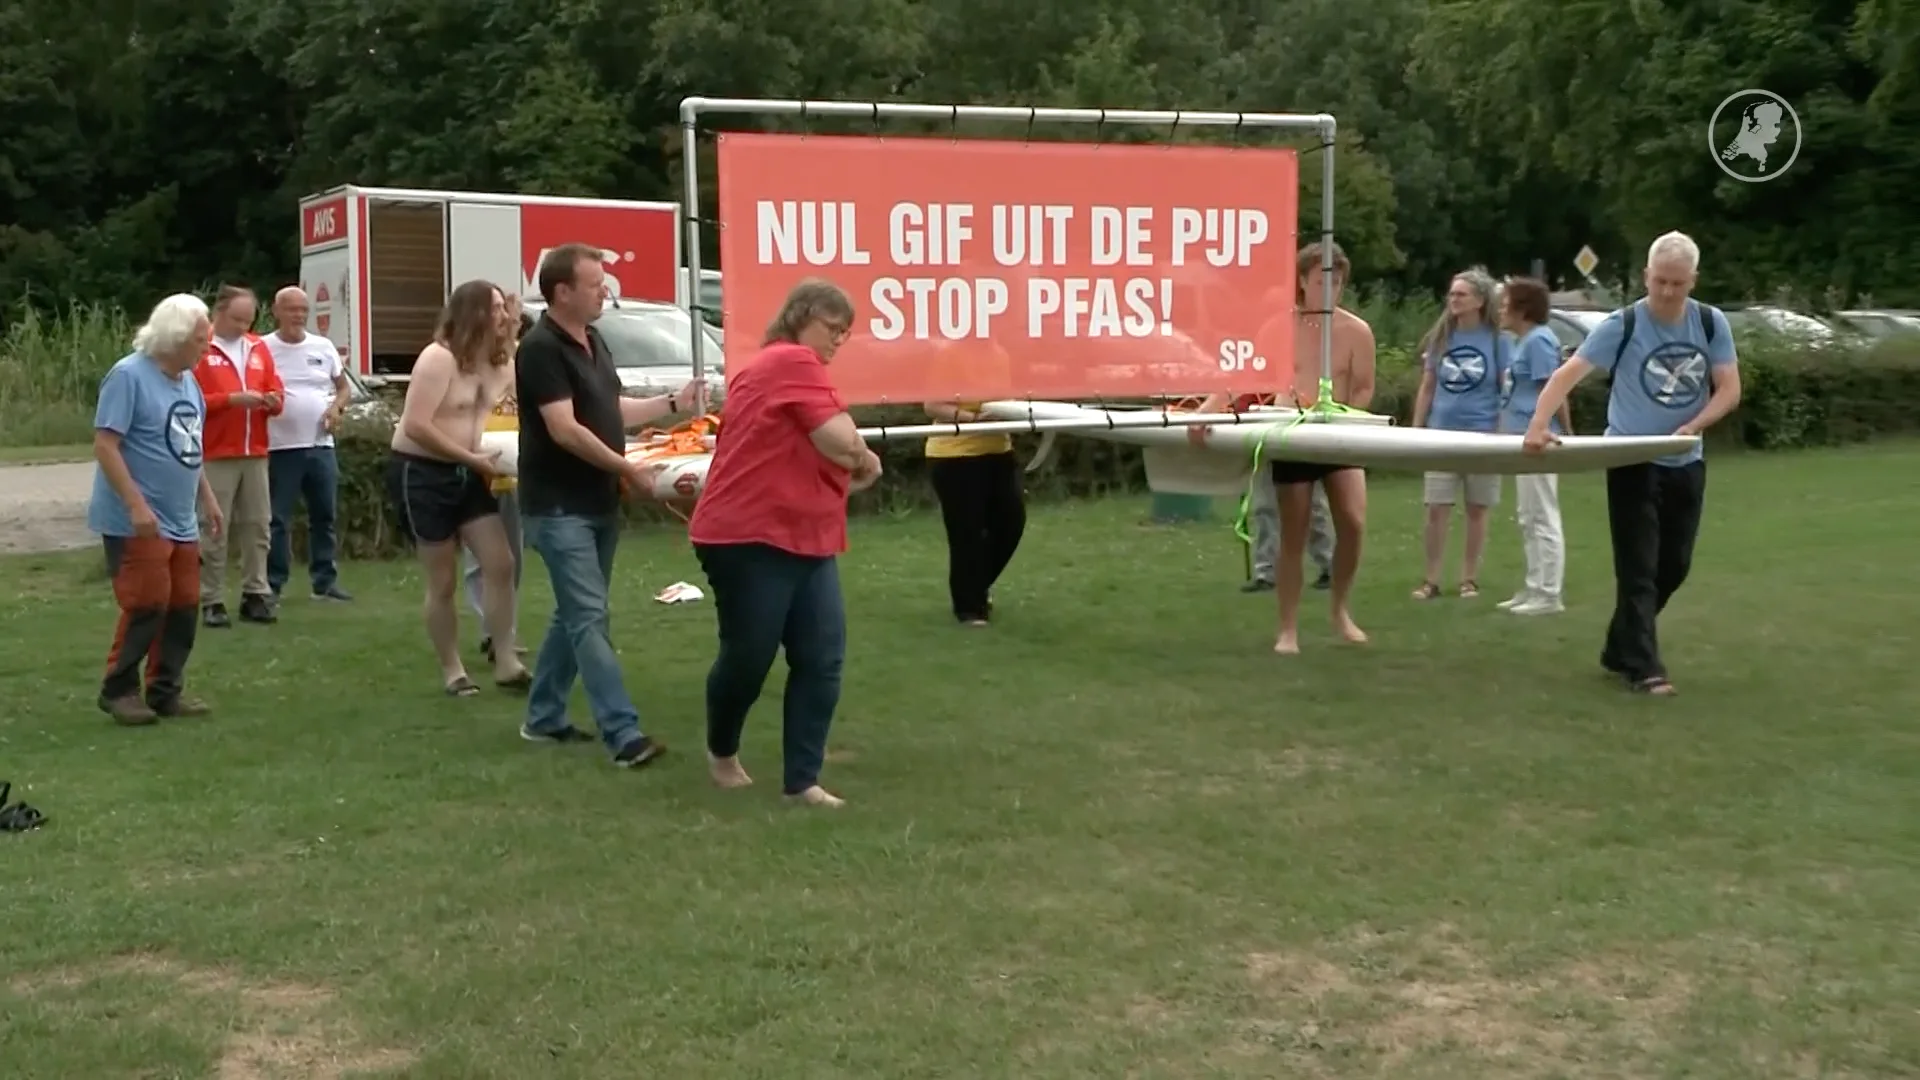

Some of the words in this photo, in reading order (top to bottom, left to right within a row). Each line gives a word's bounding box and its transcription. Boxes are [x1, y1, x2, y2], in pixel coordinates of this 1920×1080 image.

[313, 207, 336, 239] AVIS
[756, 200, 870, 266] NUL
[889, 202, 974, 266] GIF
[992, 204, 1074, 267] UIT
[1091, 206, 1153, 266] DE
[869, 277, 1009, 340] STOP
[1027, 278, 1173, 338] PFAS!
